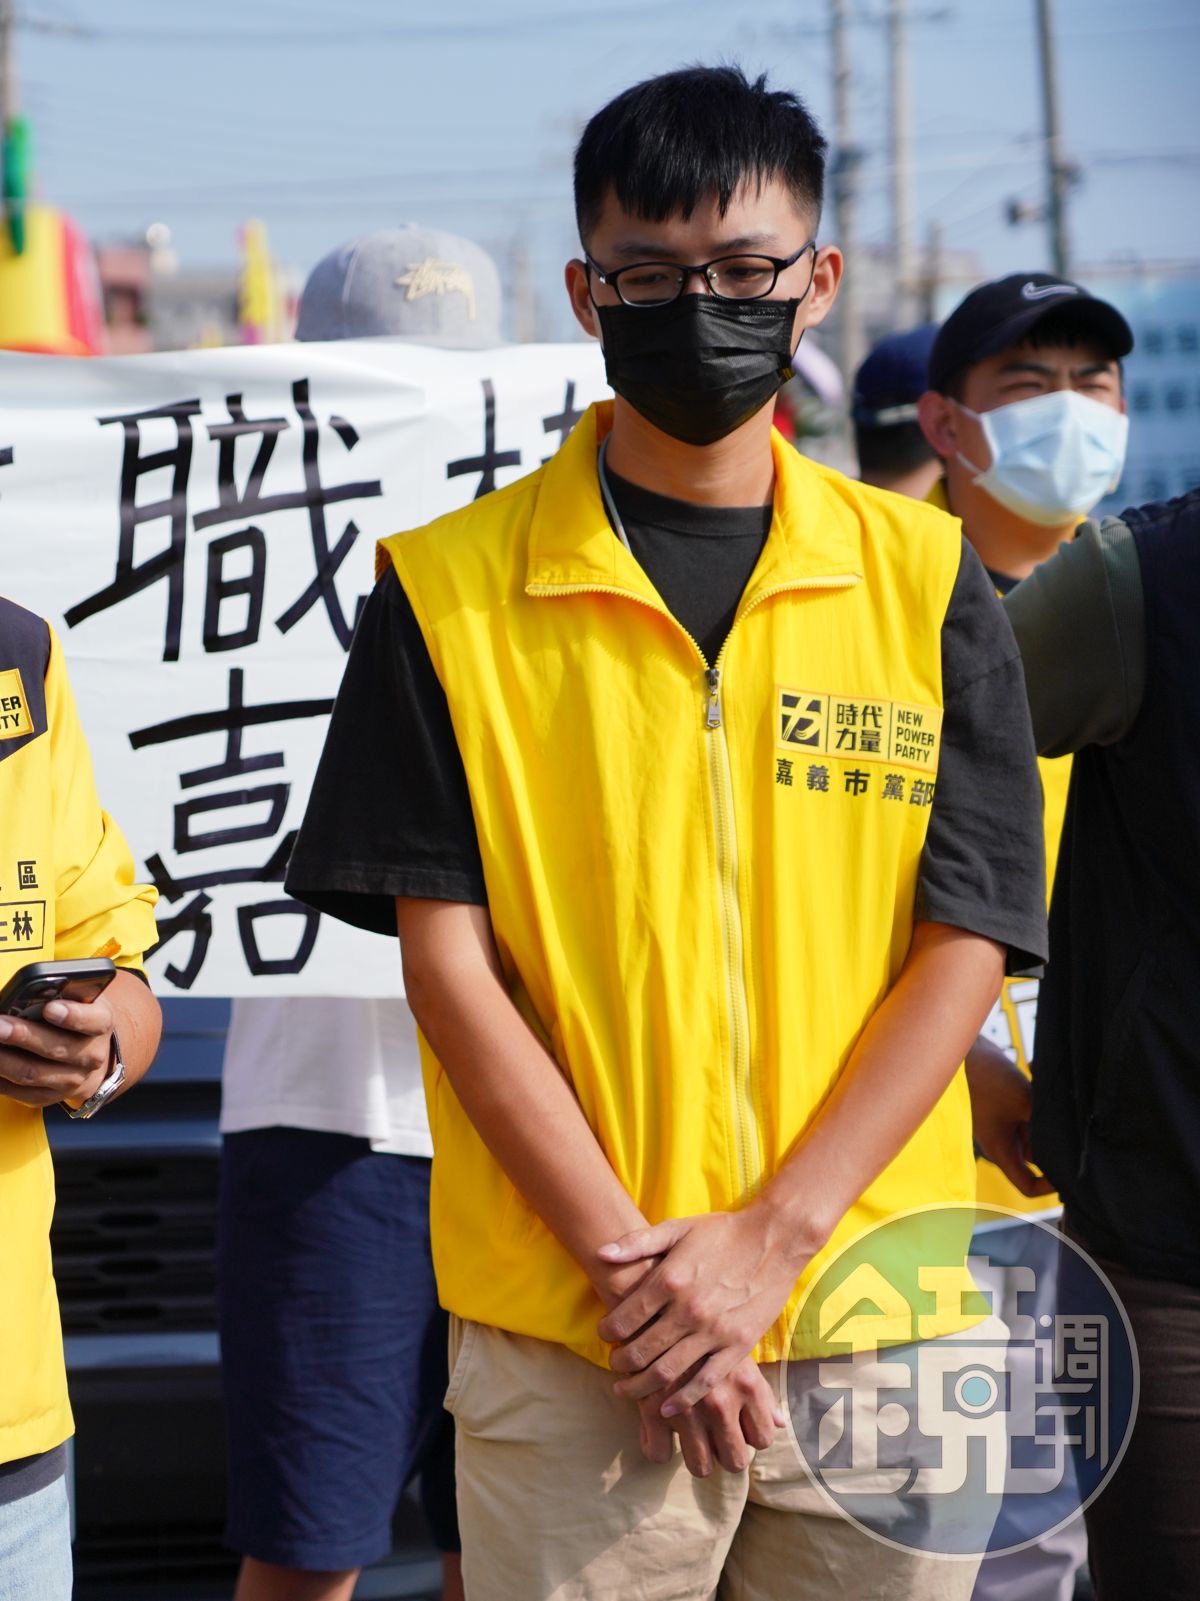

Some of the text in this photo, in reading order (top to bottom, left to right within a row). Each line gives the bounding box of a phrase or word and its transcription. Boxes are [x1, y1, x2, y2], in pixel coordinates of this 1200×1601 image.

[836, 703, 883, 728] 時代
[897, 709, 923, 727] NEW
[835, 728, 882, 753] 力量
[896, 726, 935, 747] POWER
[895, 743, 930, 763] PARTY
[776, 758, 935, 807] 嘉義市黨部
